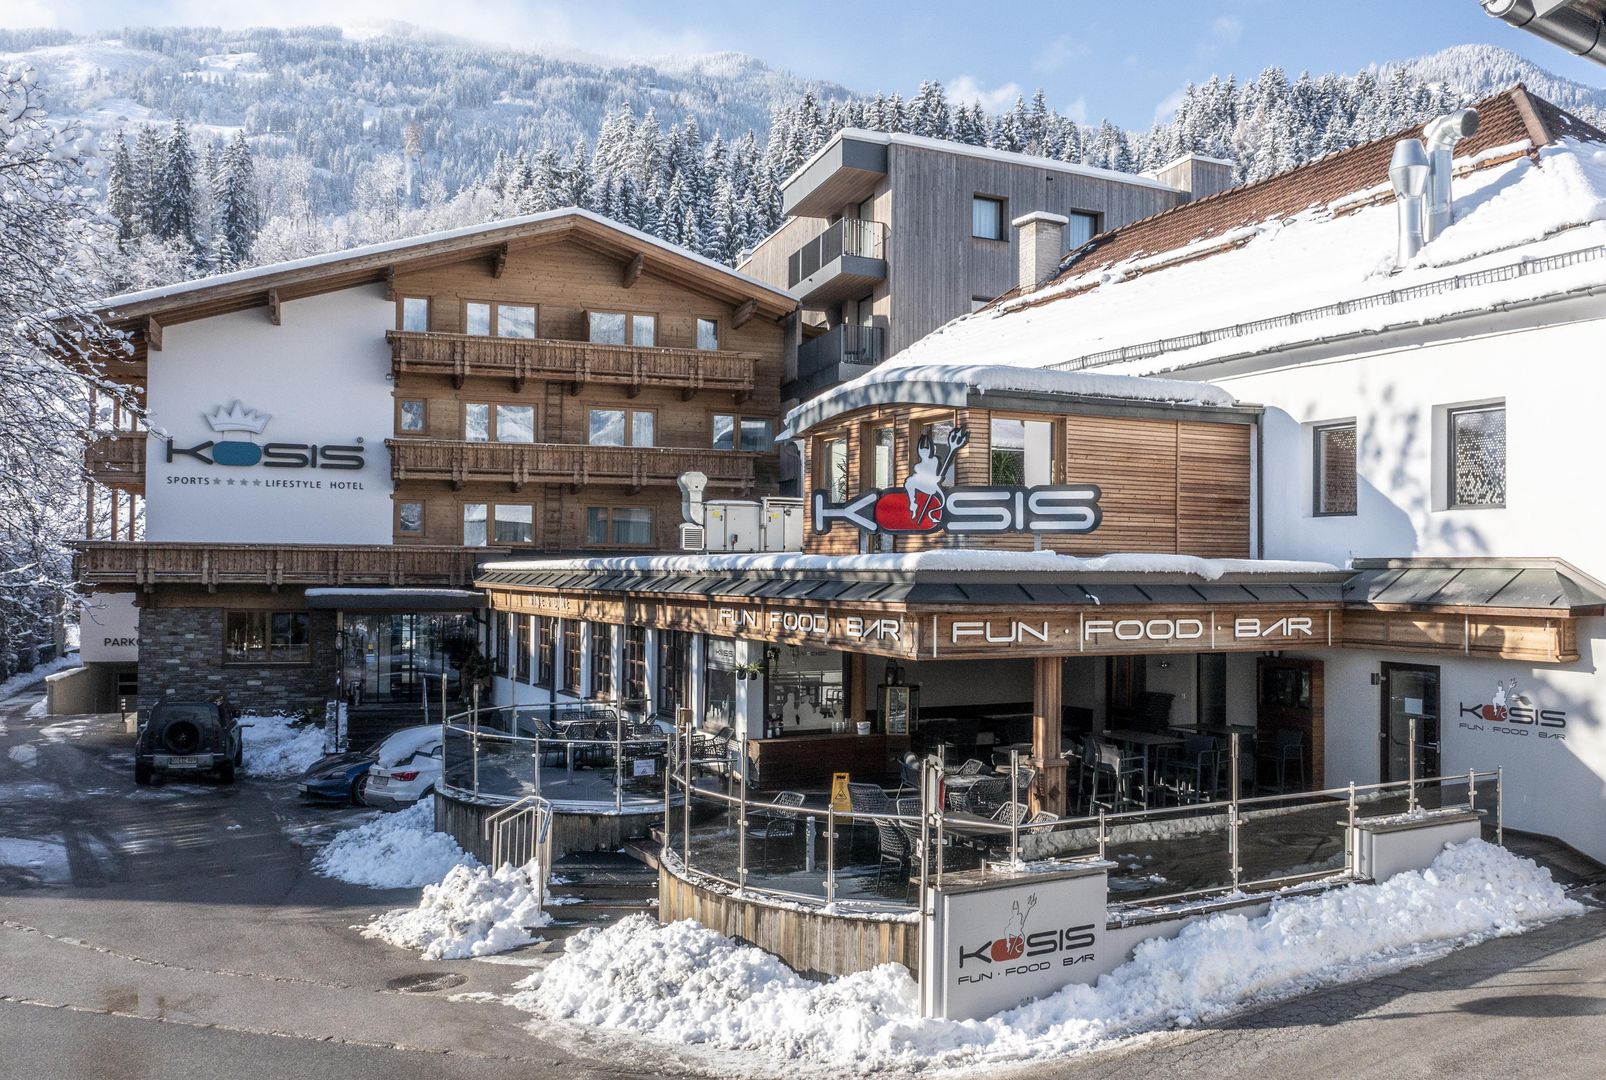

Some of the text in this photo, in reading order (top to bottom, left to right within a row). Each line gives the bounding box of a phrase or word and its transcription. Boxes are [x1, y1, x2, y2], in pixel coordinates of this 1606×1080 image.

[166, 476, 364, 490] SPORTS LIFESTYLE HOTEL
[719, 606, 901, 642] FUN FOOD BAR
[951, 616, 1313, 643] FUN FOOD BAR
[1460, 702, 1566, 729] KOSIS
[1459, 722, 1566, 741] FUN FOOD BAR
[959, 924, 1096, 969] KOSIS
[958, 953, 1095, 985] FUN FOOD BAR
